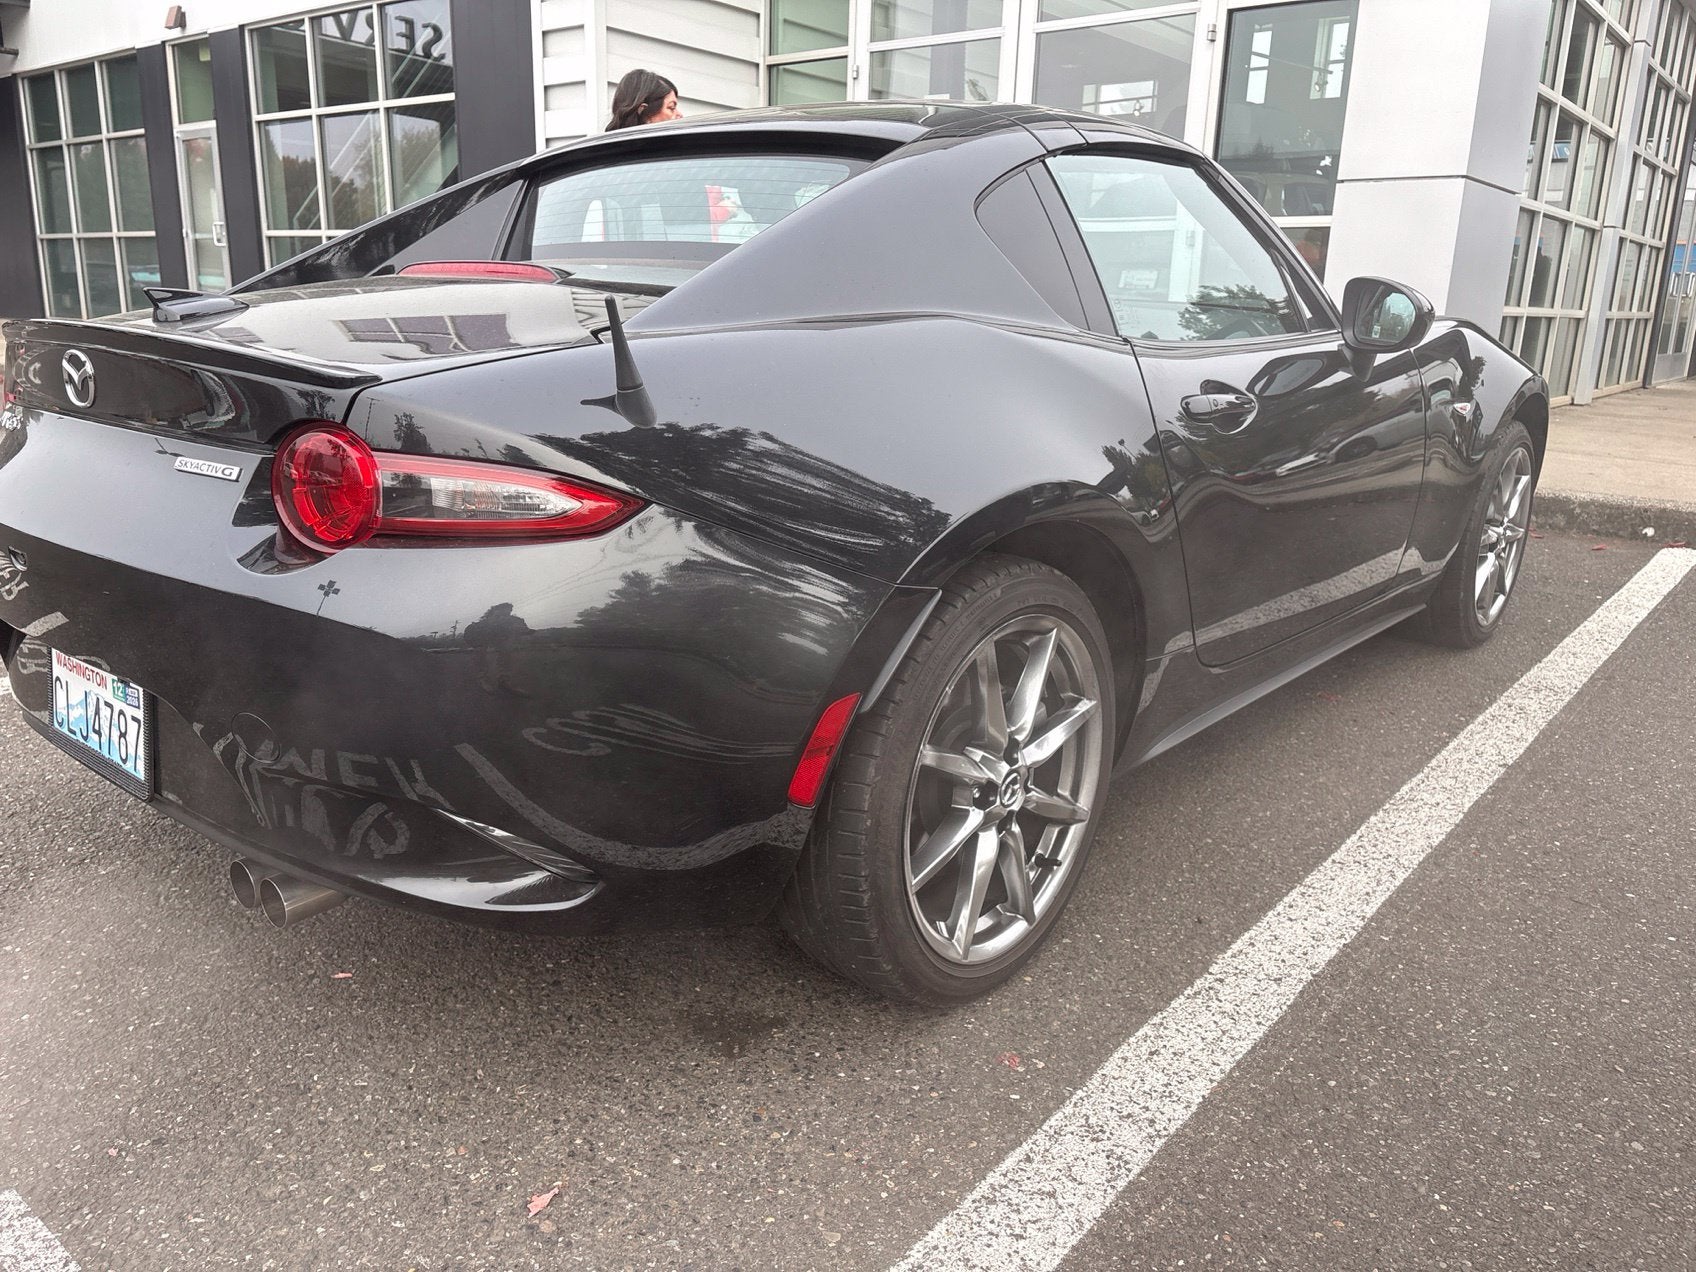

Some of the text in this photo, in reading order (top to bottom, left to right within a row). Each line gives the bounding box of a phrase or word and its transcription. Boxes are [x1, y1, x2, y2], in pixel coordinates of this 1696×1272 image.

[55, 650, 108, 690] WASHINGTON
[112, 681, 125, 697] 12
[54, 676, 142, 773] CLJ4787
